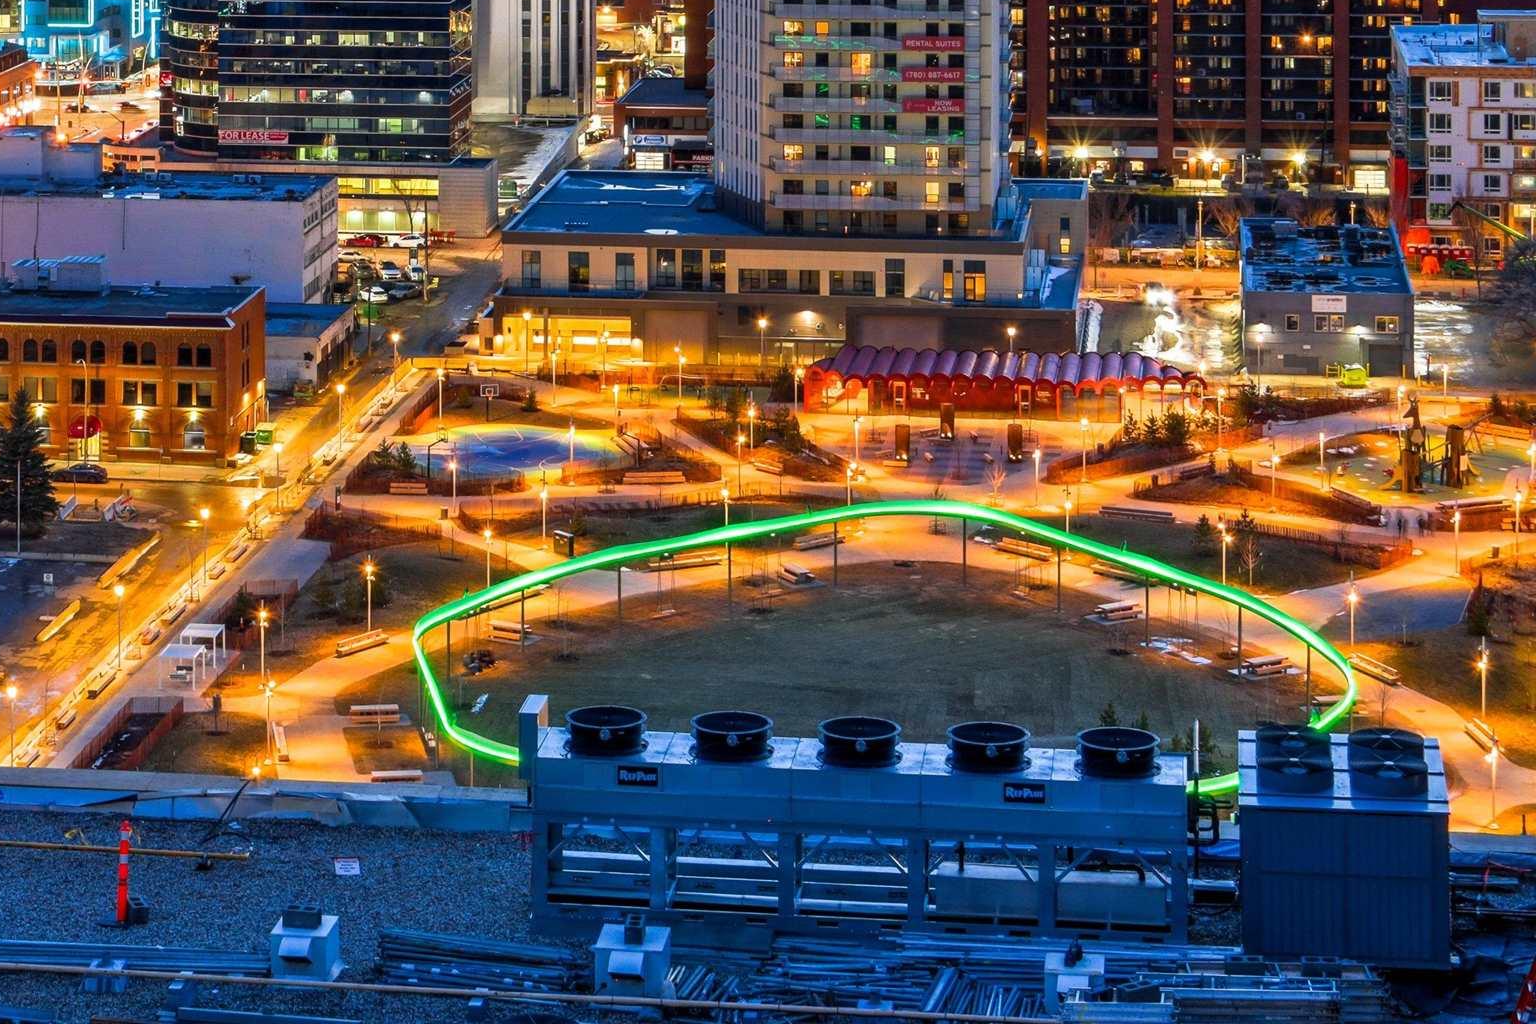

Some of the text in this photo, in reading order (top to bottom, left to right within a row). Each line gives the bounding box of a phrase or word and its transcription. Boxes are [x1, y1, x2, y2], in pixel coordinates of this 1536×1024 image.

[906, 39, 961, 48] RENTAL SUITES
[219, 131, 240, 140] FOR
[240, 131, 270, 140] LEASE
